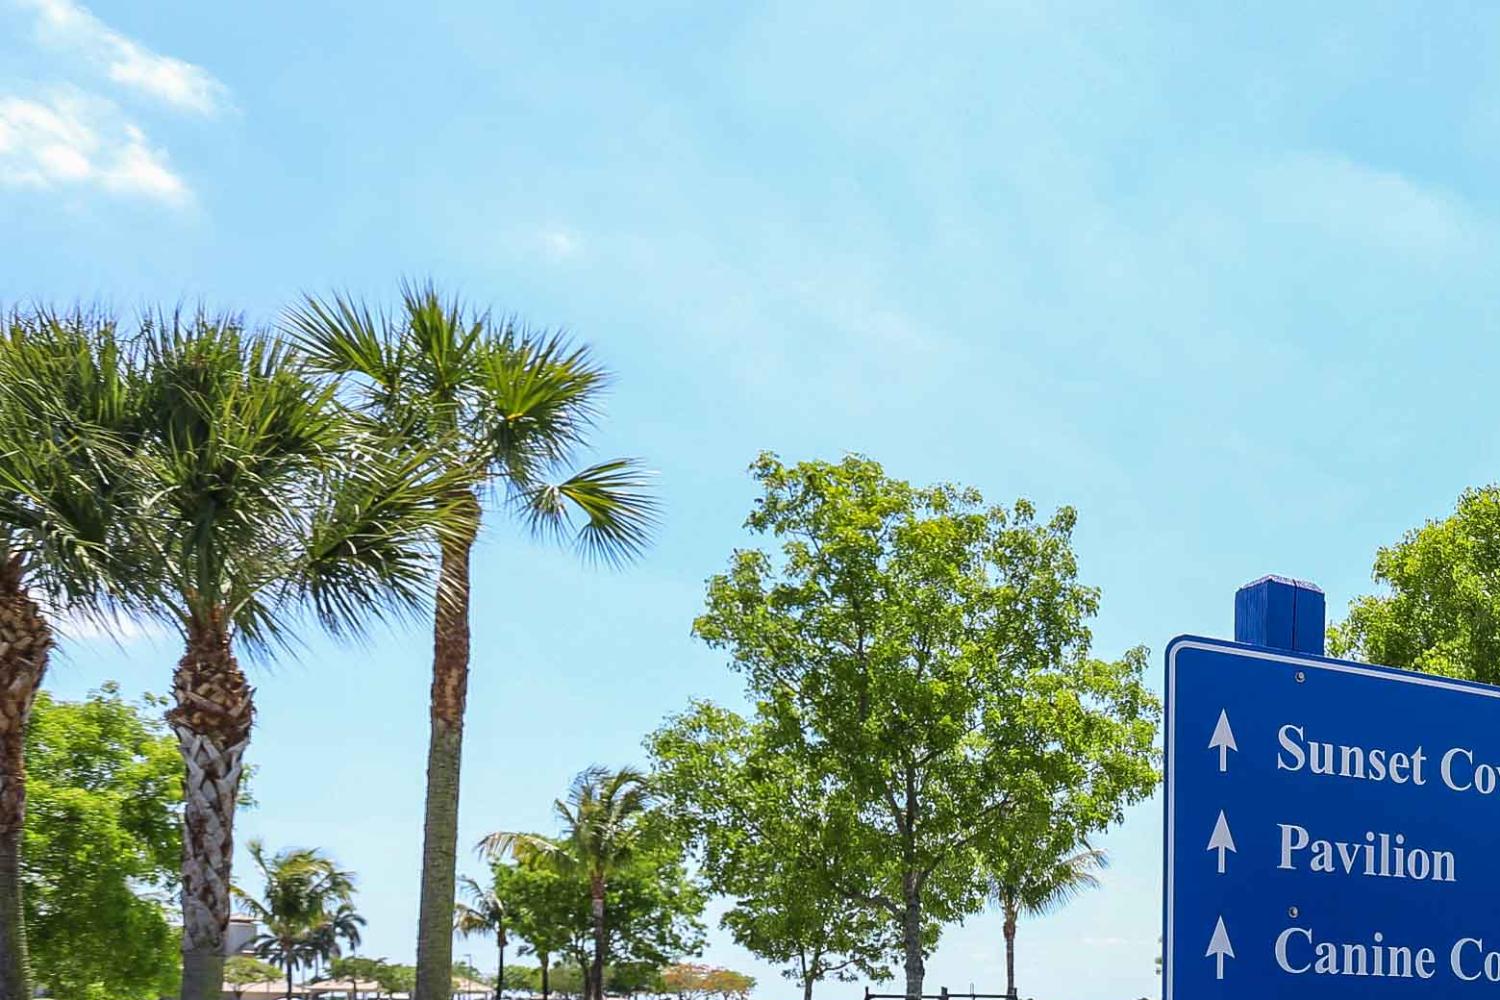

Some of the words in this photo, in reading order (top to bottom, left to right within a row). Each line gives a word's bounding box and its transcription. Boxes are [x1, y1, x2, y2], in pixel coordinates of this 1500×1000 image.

[1277, 724, 1427, 787] Sunset
[1276, 823, 1456, 883] Pavilion
[1274, 927, 1436, 980] Canine
